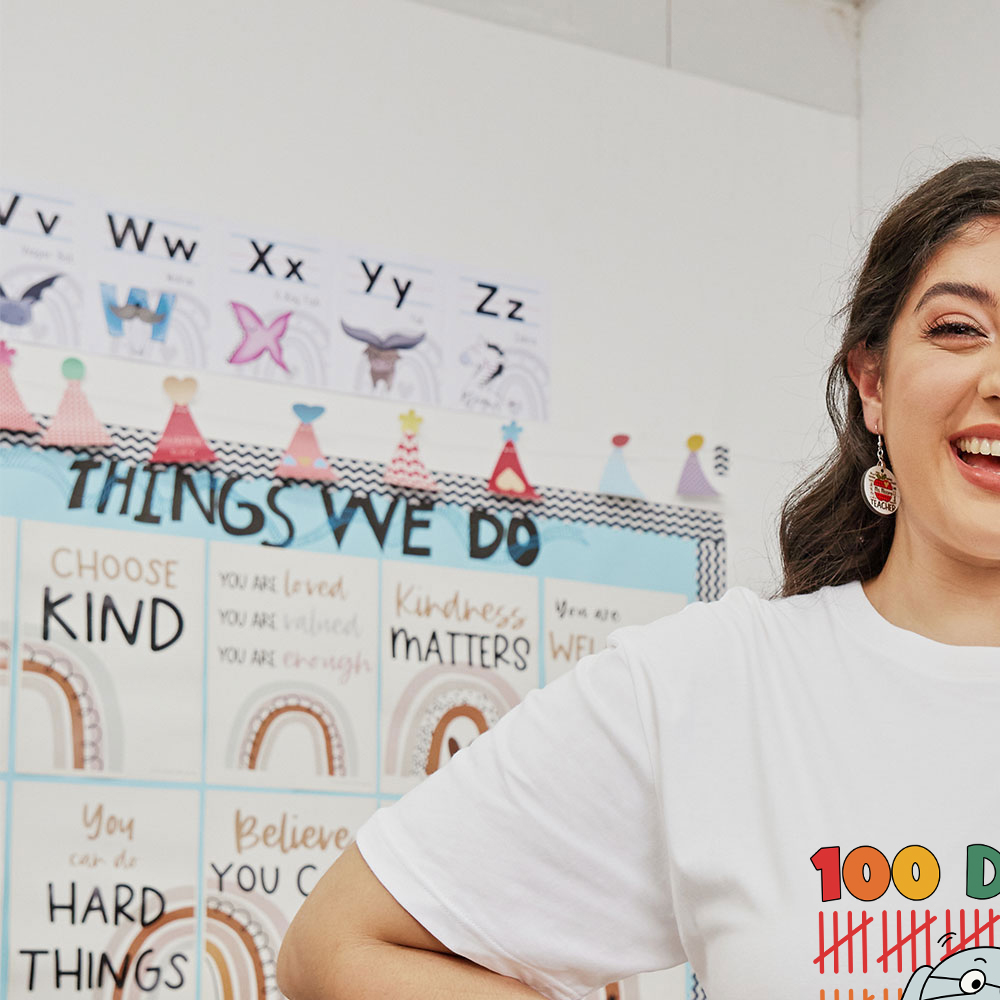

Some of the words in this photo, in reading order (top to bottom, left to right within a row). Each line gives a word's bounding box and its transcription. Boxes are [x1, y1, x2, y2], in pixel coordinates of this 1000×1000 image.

[67, 458, 295, 548] THINGS
[320, 483, 436, 558] WE
[469, 508, 541, 567] DO
[50, 546, 179, 588] CHOOSE
[218, 571, 249, 590] YOU
[282, 568, 347, 601] loved
[43, 585, 184, 652] KIND
[217, 608, 248, 627] YOU
[394, 582, 527, 631] Kindness
[217, 645, 247, 664] YOU
[391, 626, 532, 672] MATTERS
[82, 802, 136, 841] You
[234, 808, 350, 855] Believe
[210, 862, 280, 895] YOU
[810, 845, 941, 902] 100
[47, 881, 166, 928] HARD
[19, 947, 189, 993] THINGS
